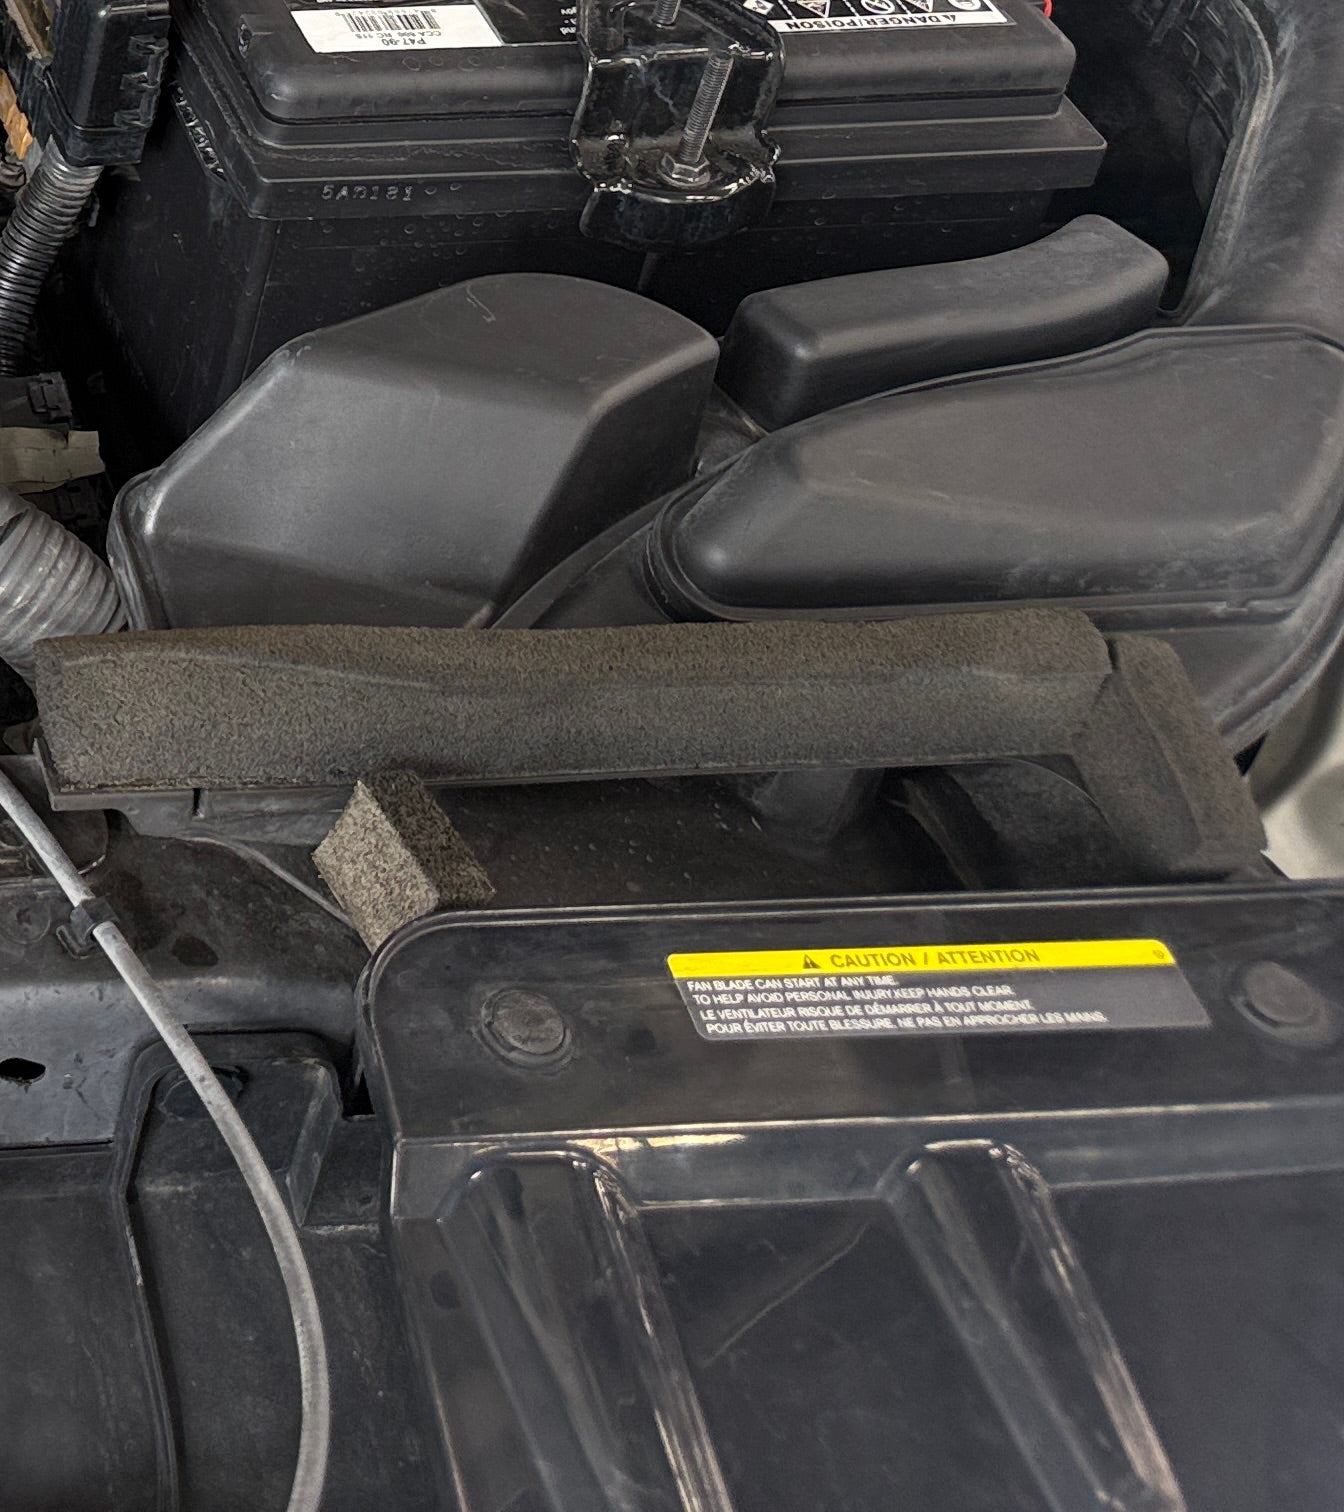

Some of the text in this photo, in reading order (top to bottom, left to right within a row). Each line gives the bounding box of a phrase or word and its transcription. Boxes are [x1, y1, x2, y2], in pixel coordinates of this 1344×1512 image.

[785, 15, 941, 33] DANGER/POISON
[830, 952, 917, 968] CAUTION
[938, 949, 1041, 966] ATTENTION
[686, 979, 712, 992] FAN
[712, 978, 753, 991] BLADE
[754, 977, 782, 990] CAN
[783, 976, 821, 989] START
[823, 976, 837, 987] AT
[841, 975, 866, 987] ANY
[692, 993, 711, 1005] TO
[713, 992, 744, 1005] HELP
[747, 991, 785, 1004] AVOID
[785, 989, 852, 1003] PERSONAL
[927, 986, 972, 998] HANDS
[700, 1009, 717, 1021] LE
[718, 1006, 795, 1020] VENTILATEUR
[797, 1005, 845, 1019] RISQUE
[846, 1004, 864, 1017] DE
[866, 1001, 933, 1015] DÉMARRER
[945, 1001, 976, 1013] TOUT
[705, 1022, 742, 1035] POUR
[743, 1018, 786, 1033] ÉVITER
[787, 1019, 828, 1032] TOUTE
[897, 1016, 916, 1029] NE
[916, 1015, 942, 1028] PAS
[943, 1014, 962, 1027] EN
[962, 1012, 1041, 1026] APPROCHER
[1040, 1012, 1064, 1024] LES
